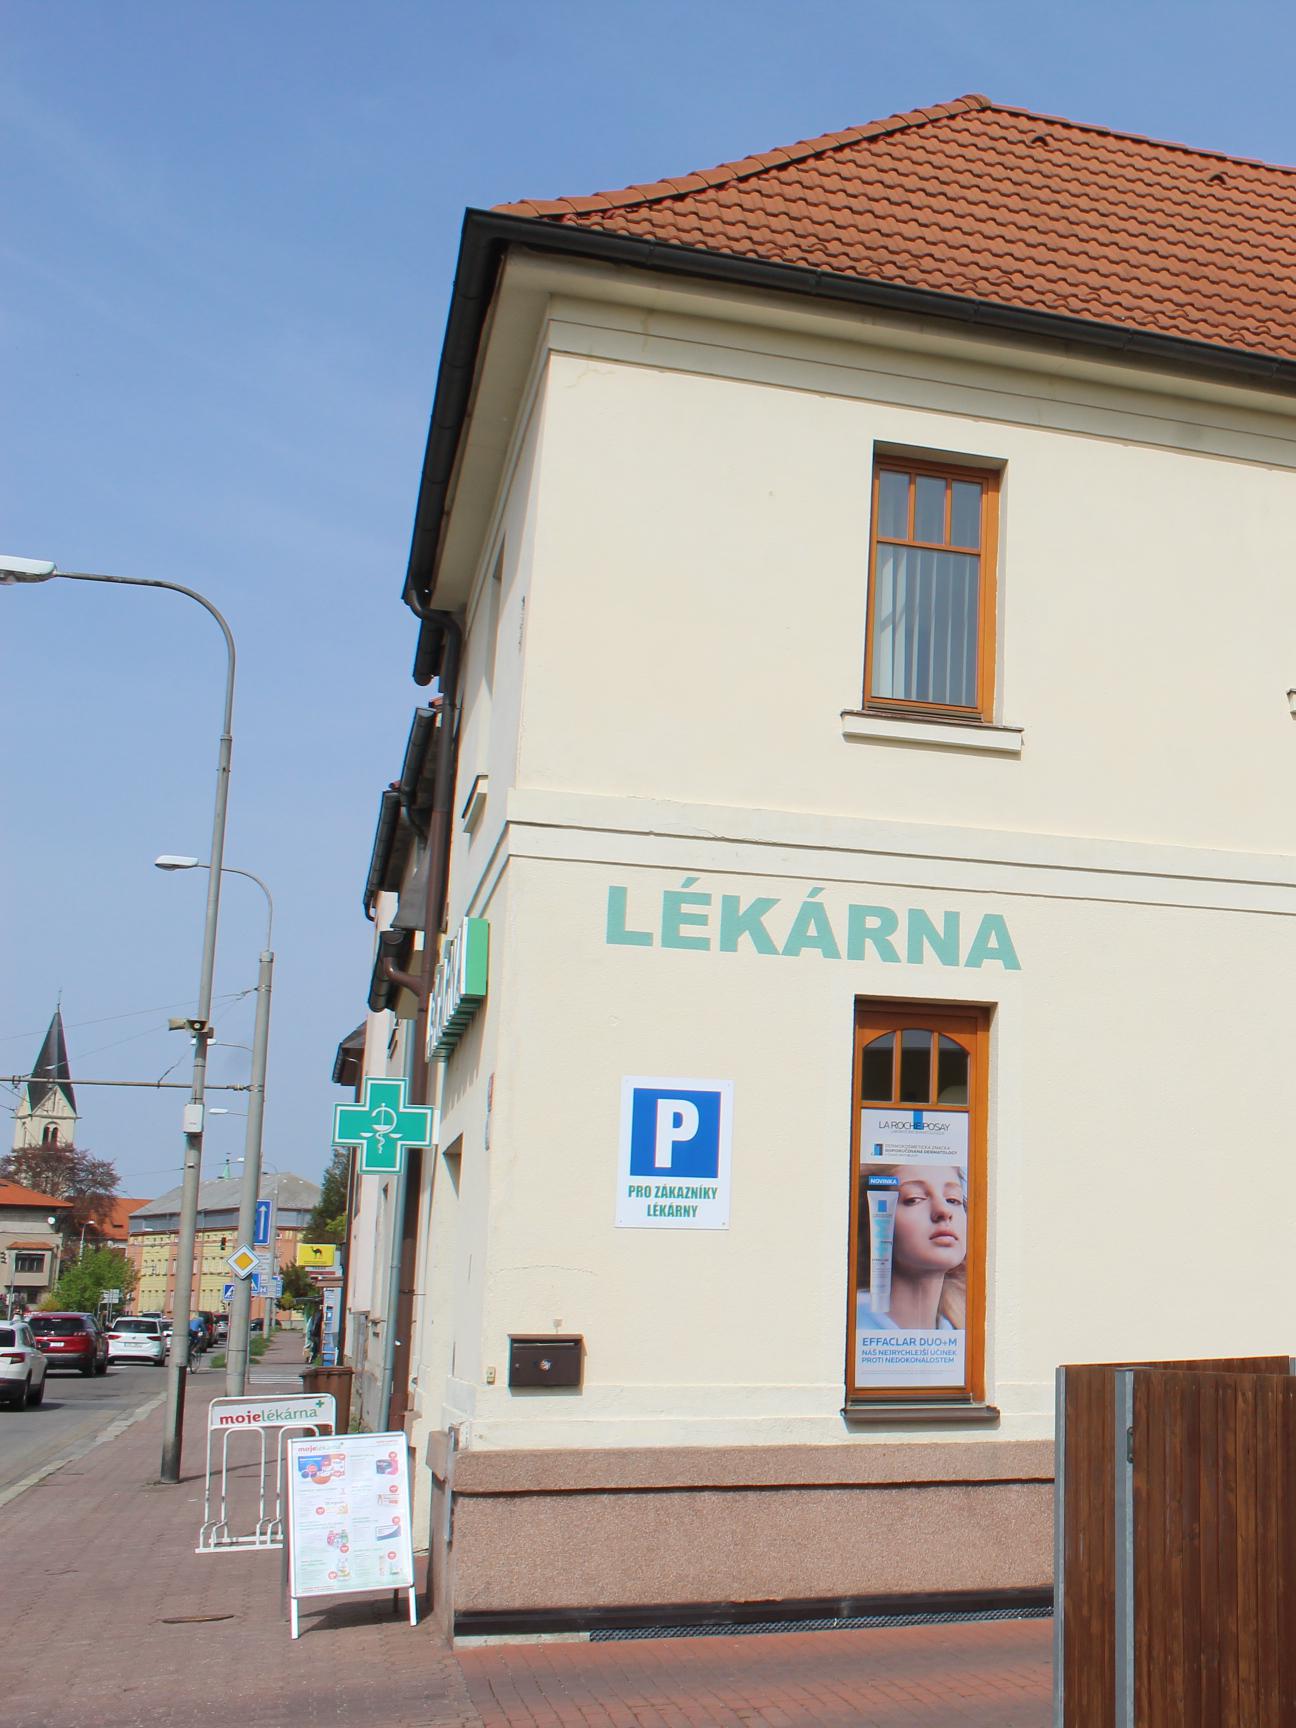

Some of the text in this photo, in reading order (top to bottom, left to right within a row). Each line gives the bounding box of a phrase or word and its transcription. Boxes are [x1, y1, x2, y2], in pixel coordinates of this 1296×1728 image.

[606, 877, 1022, 971] LÉKÁRNA
[878, 1121, 890, 1129] LA
[654, 1099, 700, 1168] P
[870, 1177, 897, 1185] NOVINKA
[628, 1184, 718, 1200] PRO ZÁKAZNÍKY
[647, 1202, 698, 1218] LÉKÁRNY
[862, 1337, 917, 1346] EFFACLAR
[219, 1407, 318, 1425] mojelékárna
